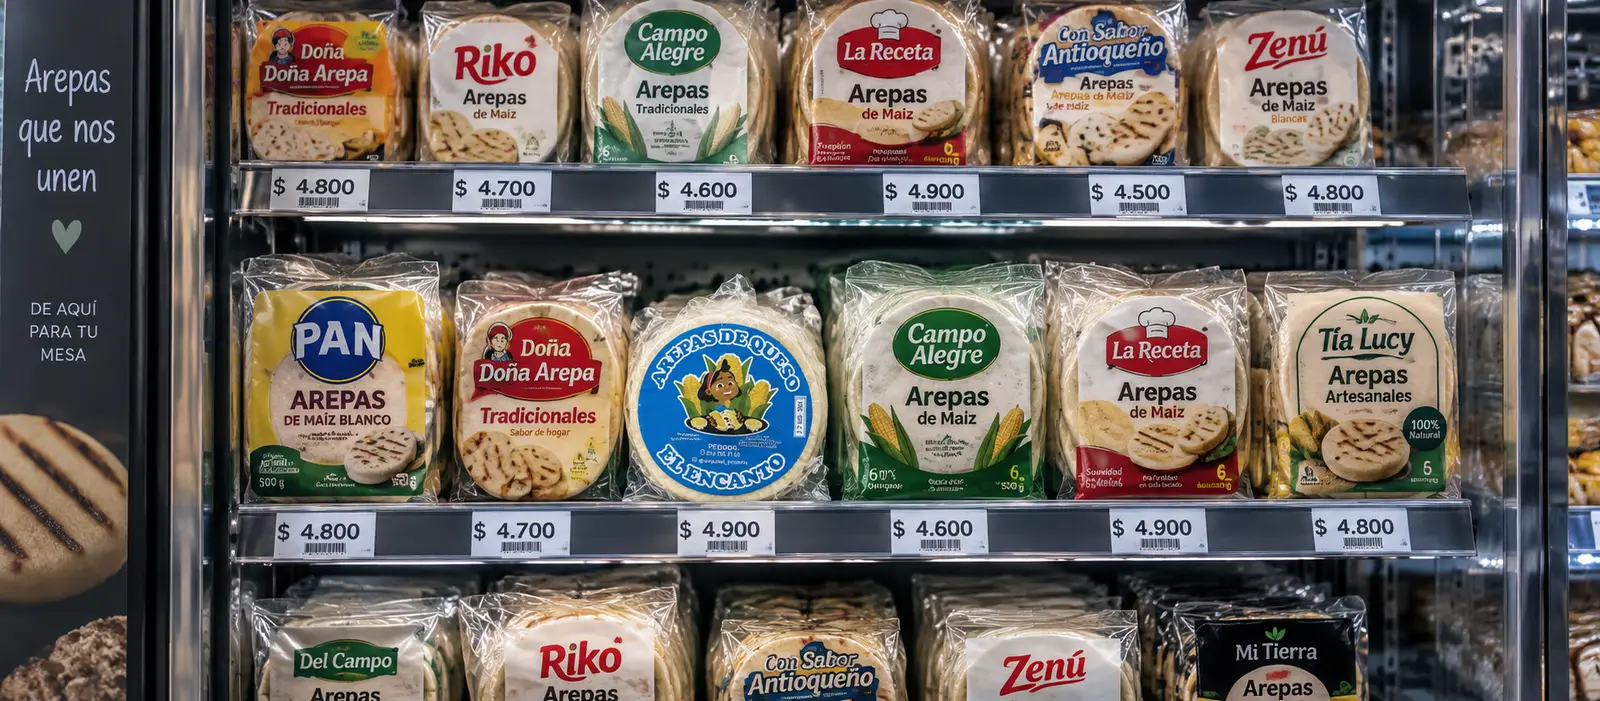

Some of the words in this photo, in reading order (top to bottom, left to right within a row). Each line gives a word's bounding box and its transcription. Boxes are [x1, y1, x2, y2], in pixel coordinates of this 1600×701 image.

[637, 22, 708, 50] Campo
[1058, 25, 1089, 42] Con
[1093, 22, 1148, 41] Sabor
[301, 43, 344, 60] Doña
[640, 44, 705, 66] Alegre
[844, 43, 867, 61] La
[871, 43, 934, 62] Receta
[1042, 36, 1164, 67] Antioqueño
[1245, 25, 1328, 71] Zenú
[455, 42, 537, 85] Riko
[24, 58, 112, 106] Arepas
[263, 63, 309, 82] Doña
[313, 64, 367, 86] Arepa
[1080, 76, 1134, 91] Arepas
[463, 89, 527, 107] Arepas
[636, 80, 709, 102] Arepas
[848, 84, 927, 106] Arepas
[1250, 78, 1327, 100] Arepas
[267, 101, 366, 116] Tradicionales
[473, 108, 488, 119] de
[490, 108, 517, 119] Maiz
[636, 104, 709, 115] Tradicionales
[862, 109, 880, 119] de
[882, 109, 914, 119] Maiz
[1262, 100, 1279, 112] de
[1283, 100, 1315, 112] Maiz
[1271, 114, 1307, 123] Blancas
[18, 118, 63, 157] que
[73, 119, 116, 144] nos
[37, 168, 97, 193] unen
[273, 177, 286, 195] $
[296, 179, 355, 194] 4.800
[455, 180, 467, 197] $
[478, 181, 536, 196] 4.700
[658, 181, 670, 198] $
[680, 182, 738, 198] 4.600
[885, 181, 898, 200] $
[908, 183, 965, 199] 4.900
[1091, 183, 1104, 201] $
[1113, 184, 1171, 200] 4.500
[1285, 184, 1298, 202] $
[1307, 185, 1364, 200] 4.800
[31, 303, 52, 316] DE
[56, 300, 98, 316] AQUÍ
[30, 325, 72, 338] PARA
[78, 325, 98, 338] TU
[294, 320, 383, 361] PAN
[908, 323, 986, 348] Campo
[1318, 326, 1353, 352] Tía
[1359, 327, 1415, 356] Lucy
[41, 348, 87, 362] MESA
[520, 339, 571, 357] Doña
[1112, 341, 1134, 359] La
[1138, 341, 1202, 362] Receta
[651, 329, 718, 390] AREPAS
[719, 328, 747, 347] DE
[748, 335, 801, 392] QUESO
[910, 346, 983, 370] Alegre
[479, 363, 530, 382] Doña
[535, 362, 596, 386] Arepa
[1328, 366, 1409, 390] Arepas
[290, 390, 386, 409] AREPAS
[905, 386, 990, 411] Arepas
[1117, 382, 1197, 405] Arepas
[1325, 390, 1412, 404] Artesanales
[284, 415, 300, 426] DE
[304, 412, 336, 426] MAÍZ
[339, 415, 391, 426] BLANCO
[480, 407, 596, 424] Tradicionales
[917, 411, 936, 425] de
[940, 411, 977, 425] Maiz
[1130, 405, 1147, 419] de
[1151, 405, 1185, 419] Maiz
[510, 428, 533, 436] Sabor
[535, 428, 545, 436] de
[546, 428, 570, 439] hogar
[1412, 419, 1440, 430] 100%
[657, 444, 685, 475] EL
[682, 453, 786, 490] ENCANTO
[1423, 460, 1432, 476] 6
[277, 522, 290, 542] $
[300, 523, 360, 540] 4.800
[473, 521, 487, 541] $
[497, 522, 556, 539] 4.700
[680, 520, 692, 540] $
[702, 521, 760, 538] 4.900
[893, 519, 905, 539] $
[915, 520, 973, 537] 4.600
[1112, 519, 1125, 538] $
[1134, 519, 1192, 536] 4.900
[1314, 518, 1327, 537] $
[1337, 518, 1394, 535] 4.800
[540, 640, 623, 682] Riko
[764, 654, 799, 672] Con
[802, 650, 859, 670] Sabor
[1236, 644, 1259, 661] Mi
[1262, 642, 1318, 660] Tierra
[300, 653, 328, 669] Del
[332, 653, 392, 673] Campo
[1000, 649, 1087, 696] Zenú
[747, 667, 875, 698] Antioqueño
[1243, 680, 1313, 700] Arepas
[311, 688, 381, 701] Arepas
[543, 686, 619, 701] Arepas
